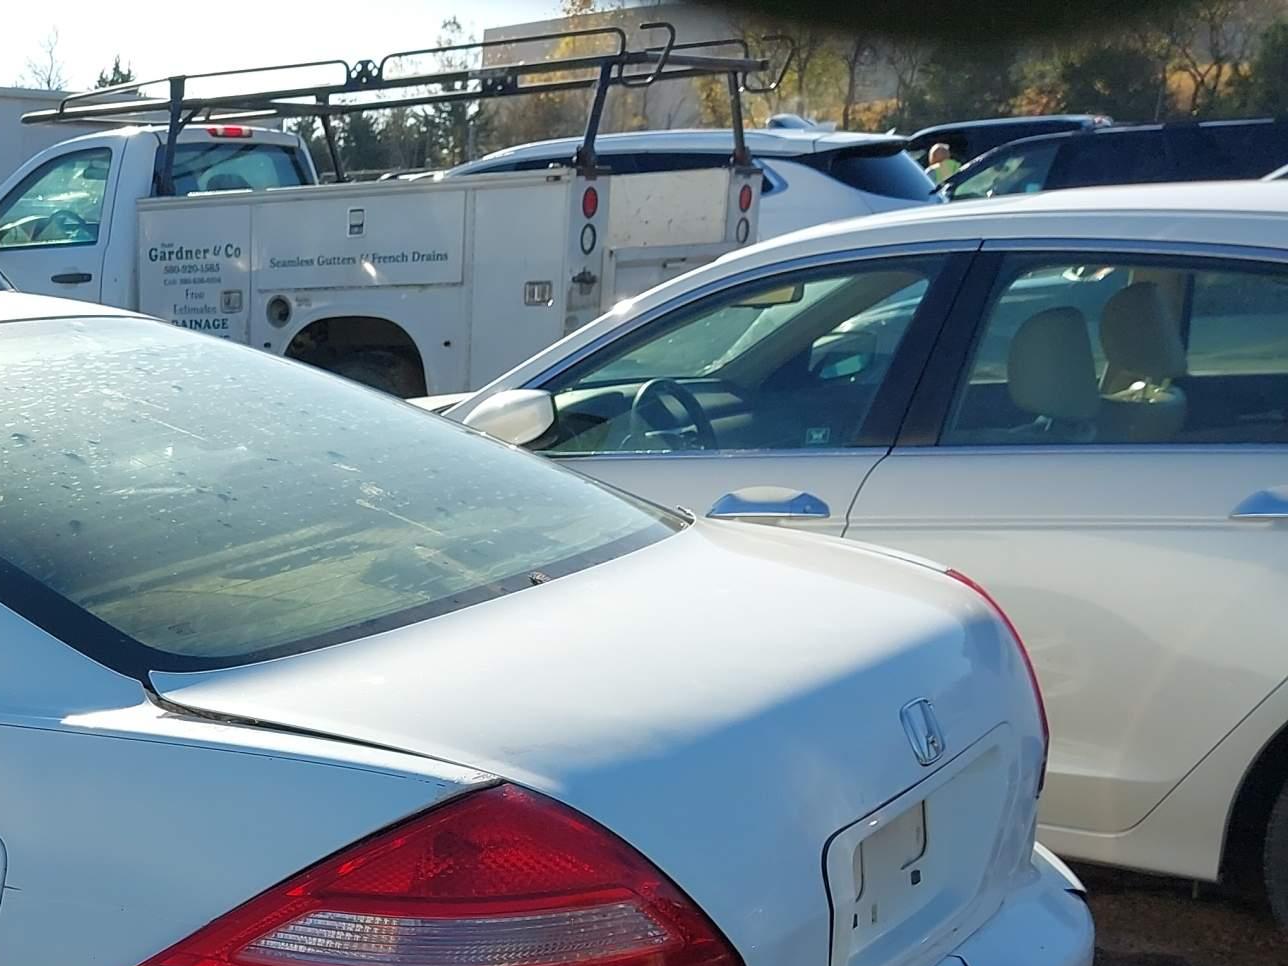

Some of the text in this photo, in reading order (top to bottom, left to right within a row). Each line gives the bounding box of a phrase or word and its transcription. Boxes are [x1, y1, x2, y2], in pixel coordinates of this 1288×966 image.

[149, 246, 209, 262] Gardner
[225, 243, 241, 258] Co
[269, 257, 314, 269] Seamless
[317, 256, 356, 267] Gutters
[371, 252, 408, 263] French
[412, 250, 449, 262] Drains
